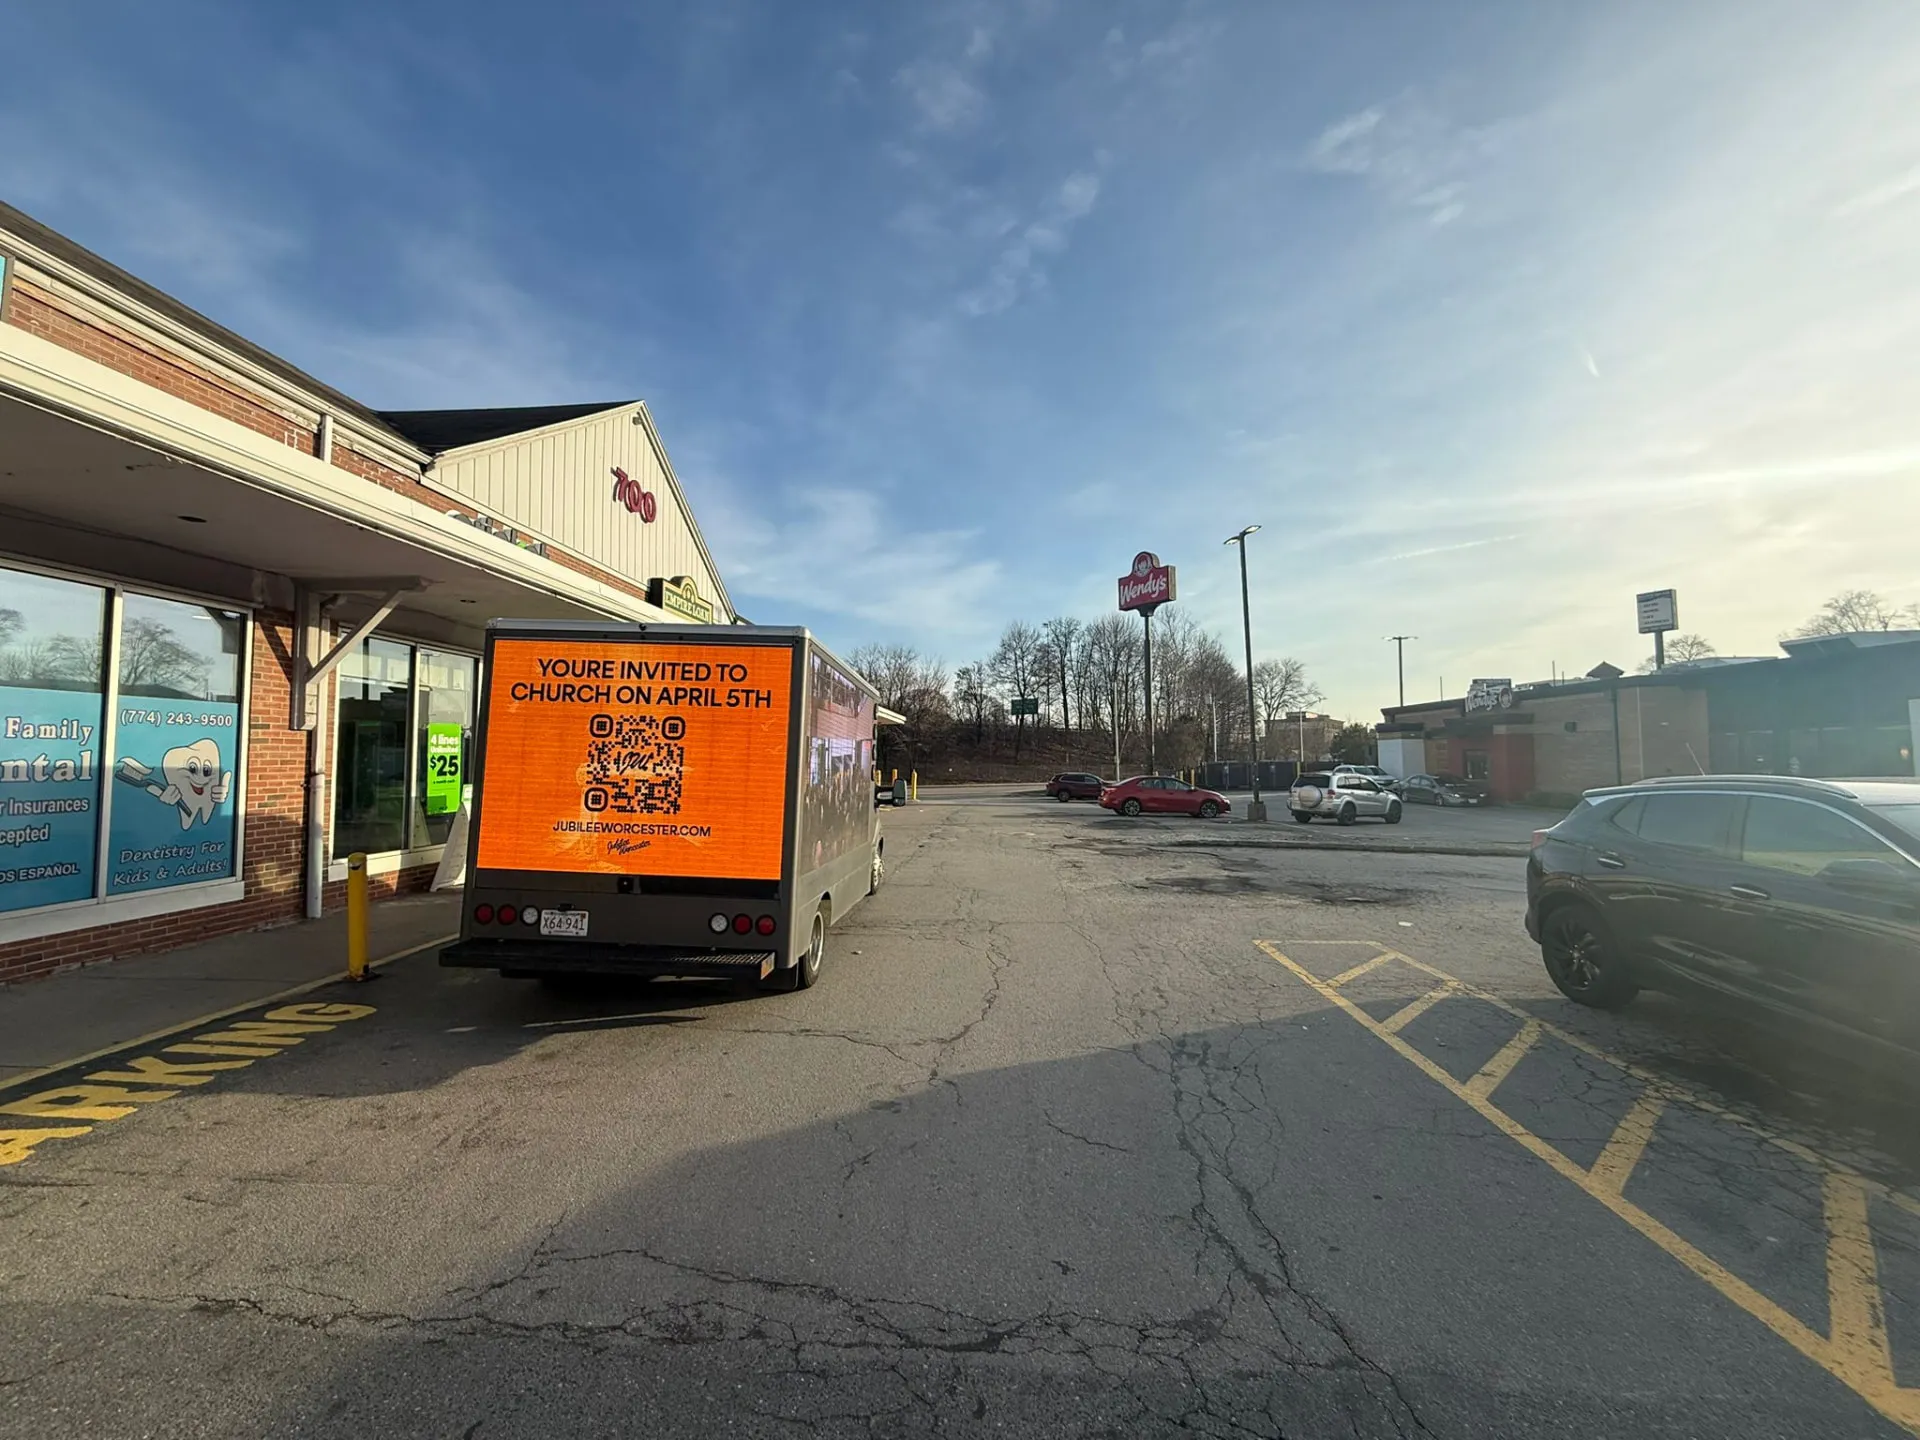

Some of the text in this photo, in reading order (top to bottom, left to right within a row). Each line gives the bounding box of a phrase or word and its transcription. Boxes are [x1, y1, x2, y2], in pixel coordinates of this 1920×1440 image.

[610, 467, 656, 523] 700
[1120, 573, 1167, 606] Wendy's
[537, 658, 748, 682] YOURE INVITED TO
[510, 682, 772, 708] CHURCH ON APRIL 5TH
[120, 709, 233, 727] (774) 243-9500
[5, 716, 93, 746] Family
[0, 750, 92, 782] ntal
[430, 754, 459, 777] $25
[9, 799, 89, 815] Insurances
[552, 821, 712, 837] JUBILEEWORCESTER.COM
[120, 841, 224, 863] Dentistry For
[19, 863, 79, 880] ESPAÑOL
[113, 859, 228, 886] Kids & Adults!
